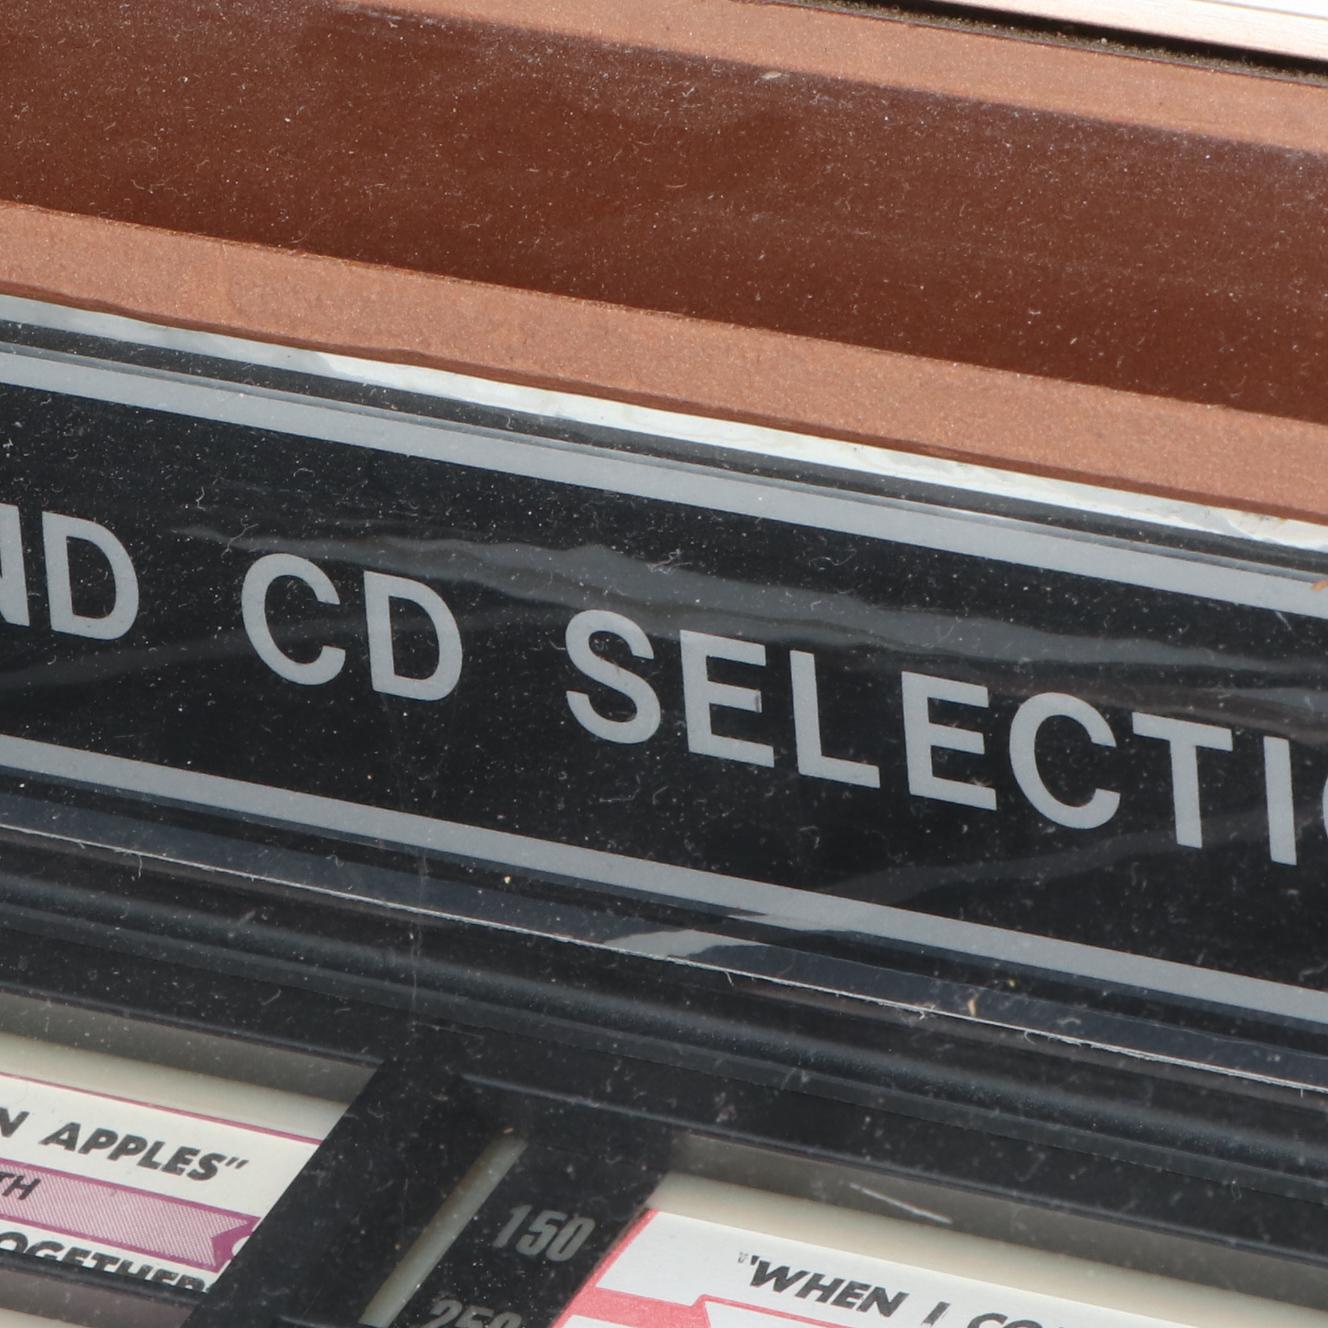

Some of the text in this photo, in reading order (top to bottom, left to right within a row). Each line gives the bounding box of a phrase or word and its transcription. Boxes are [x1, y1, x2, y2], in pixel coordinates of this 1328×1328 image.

[238, 551, 463, 705] CD
[39, 1122, 249, 1182] APPLES"
[491, 1203, 596, 1264] 150
[921, 1301, 951, 1327] I
